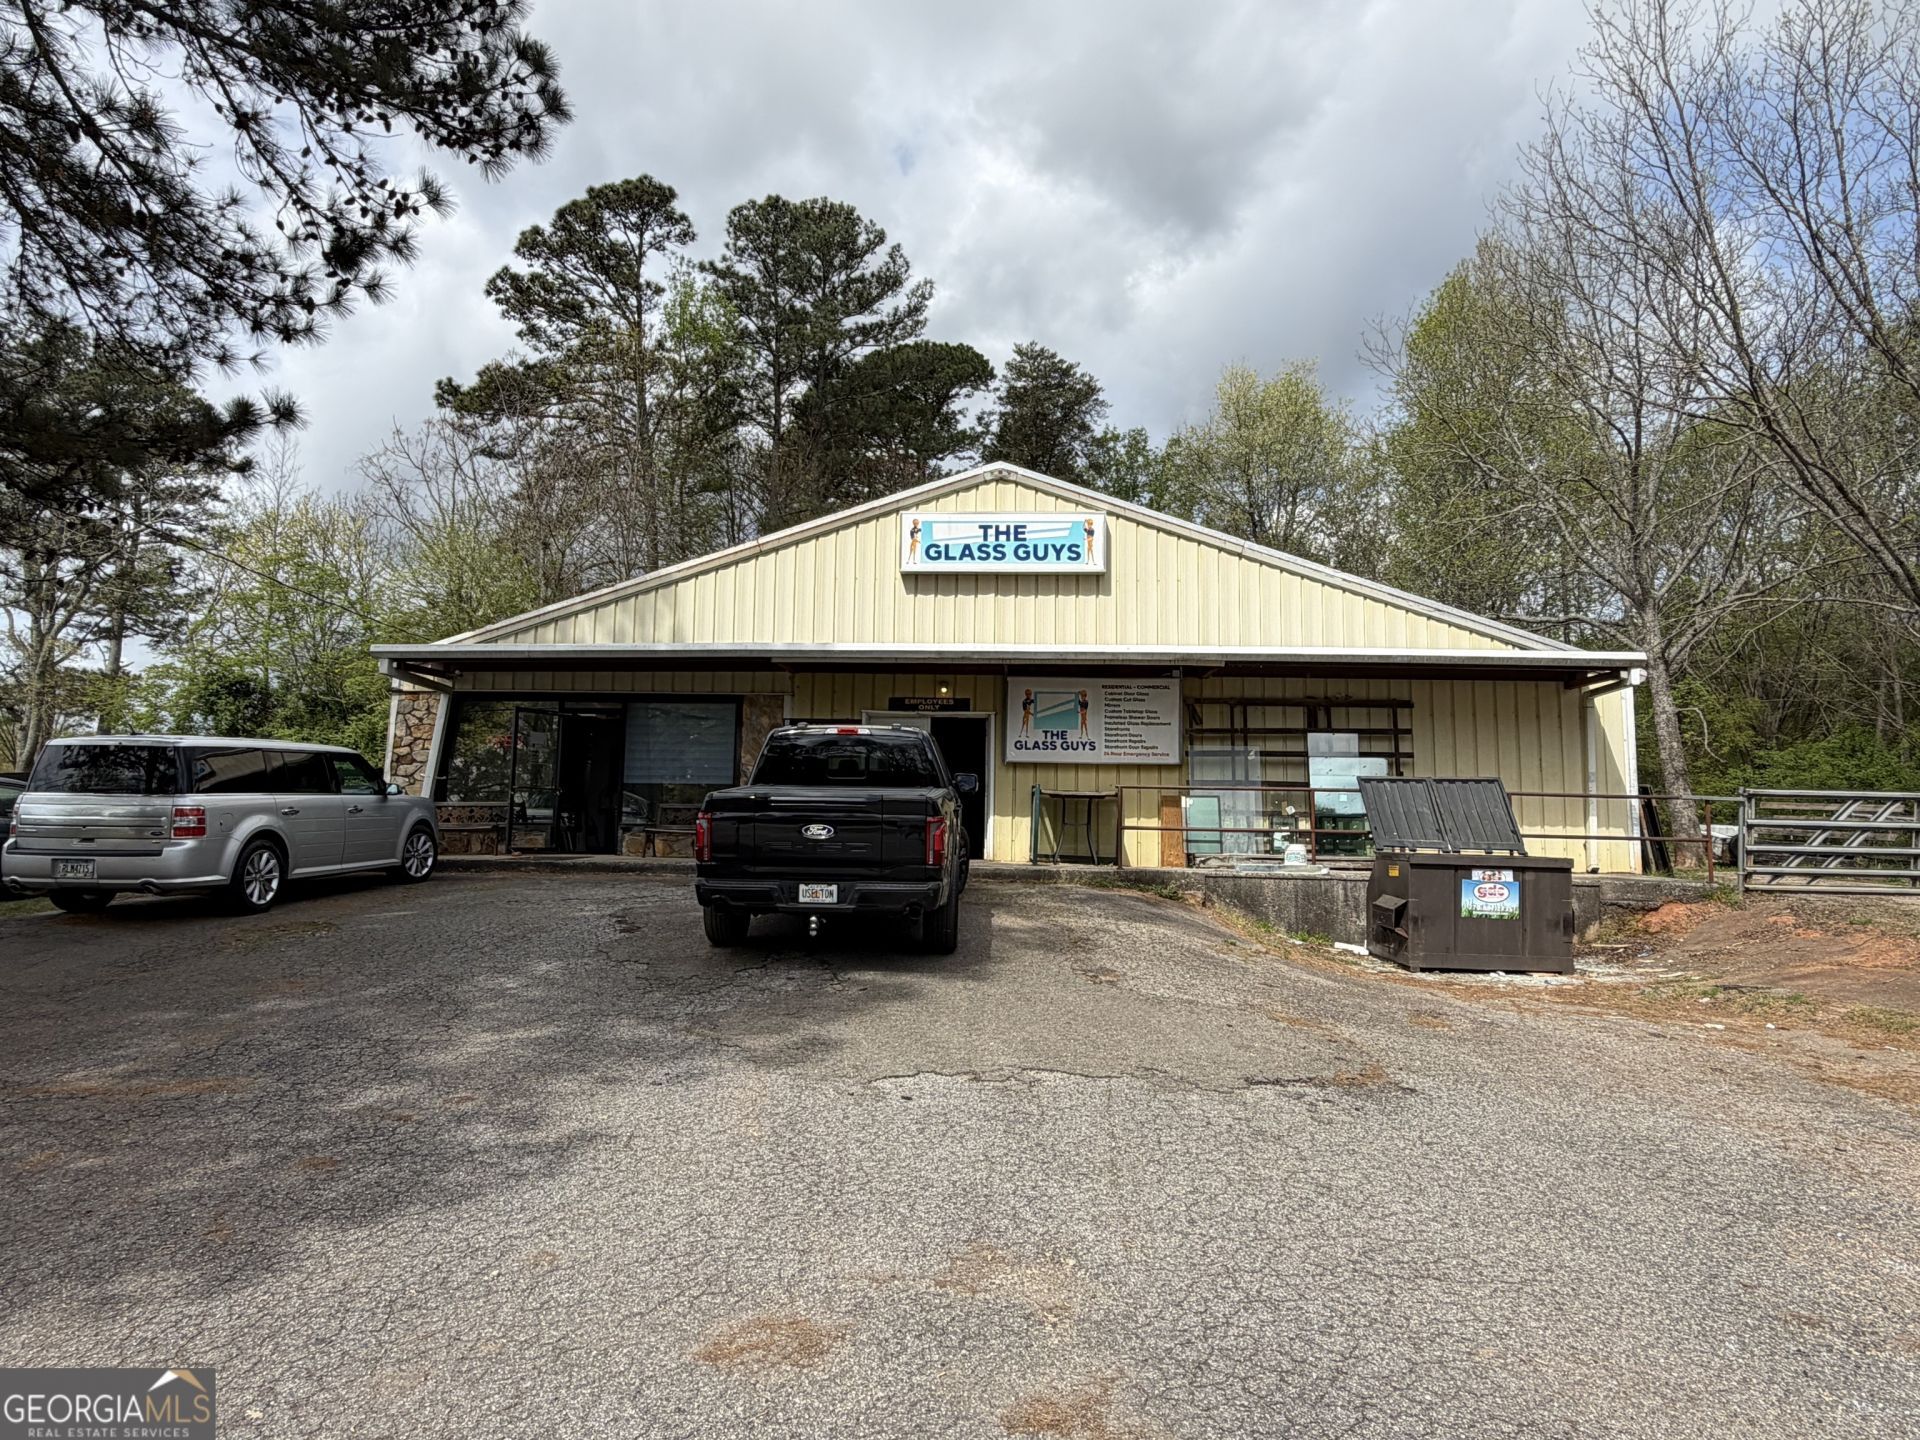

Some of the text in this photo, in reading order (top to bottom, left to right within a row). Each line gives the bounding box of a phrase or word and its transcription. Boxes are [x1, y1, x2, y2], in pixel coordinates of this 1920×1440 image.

[979, 524, 1028, 542] THE
[925, 543, 1082, 561] GLASS GUYS
[1042, 730, 1068, 740] THE
[1014, 740, 1096, 751] GLASS GUYS
[801, 888, 834, 899] USELTON
